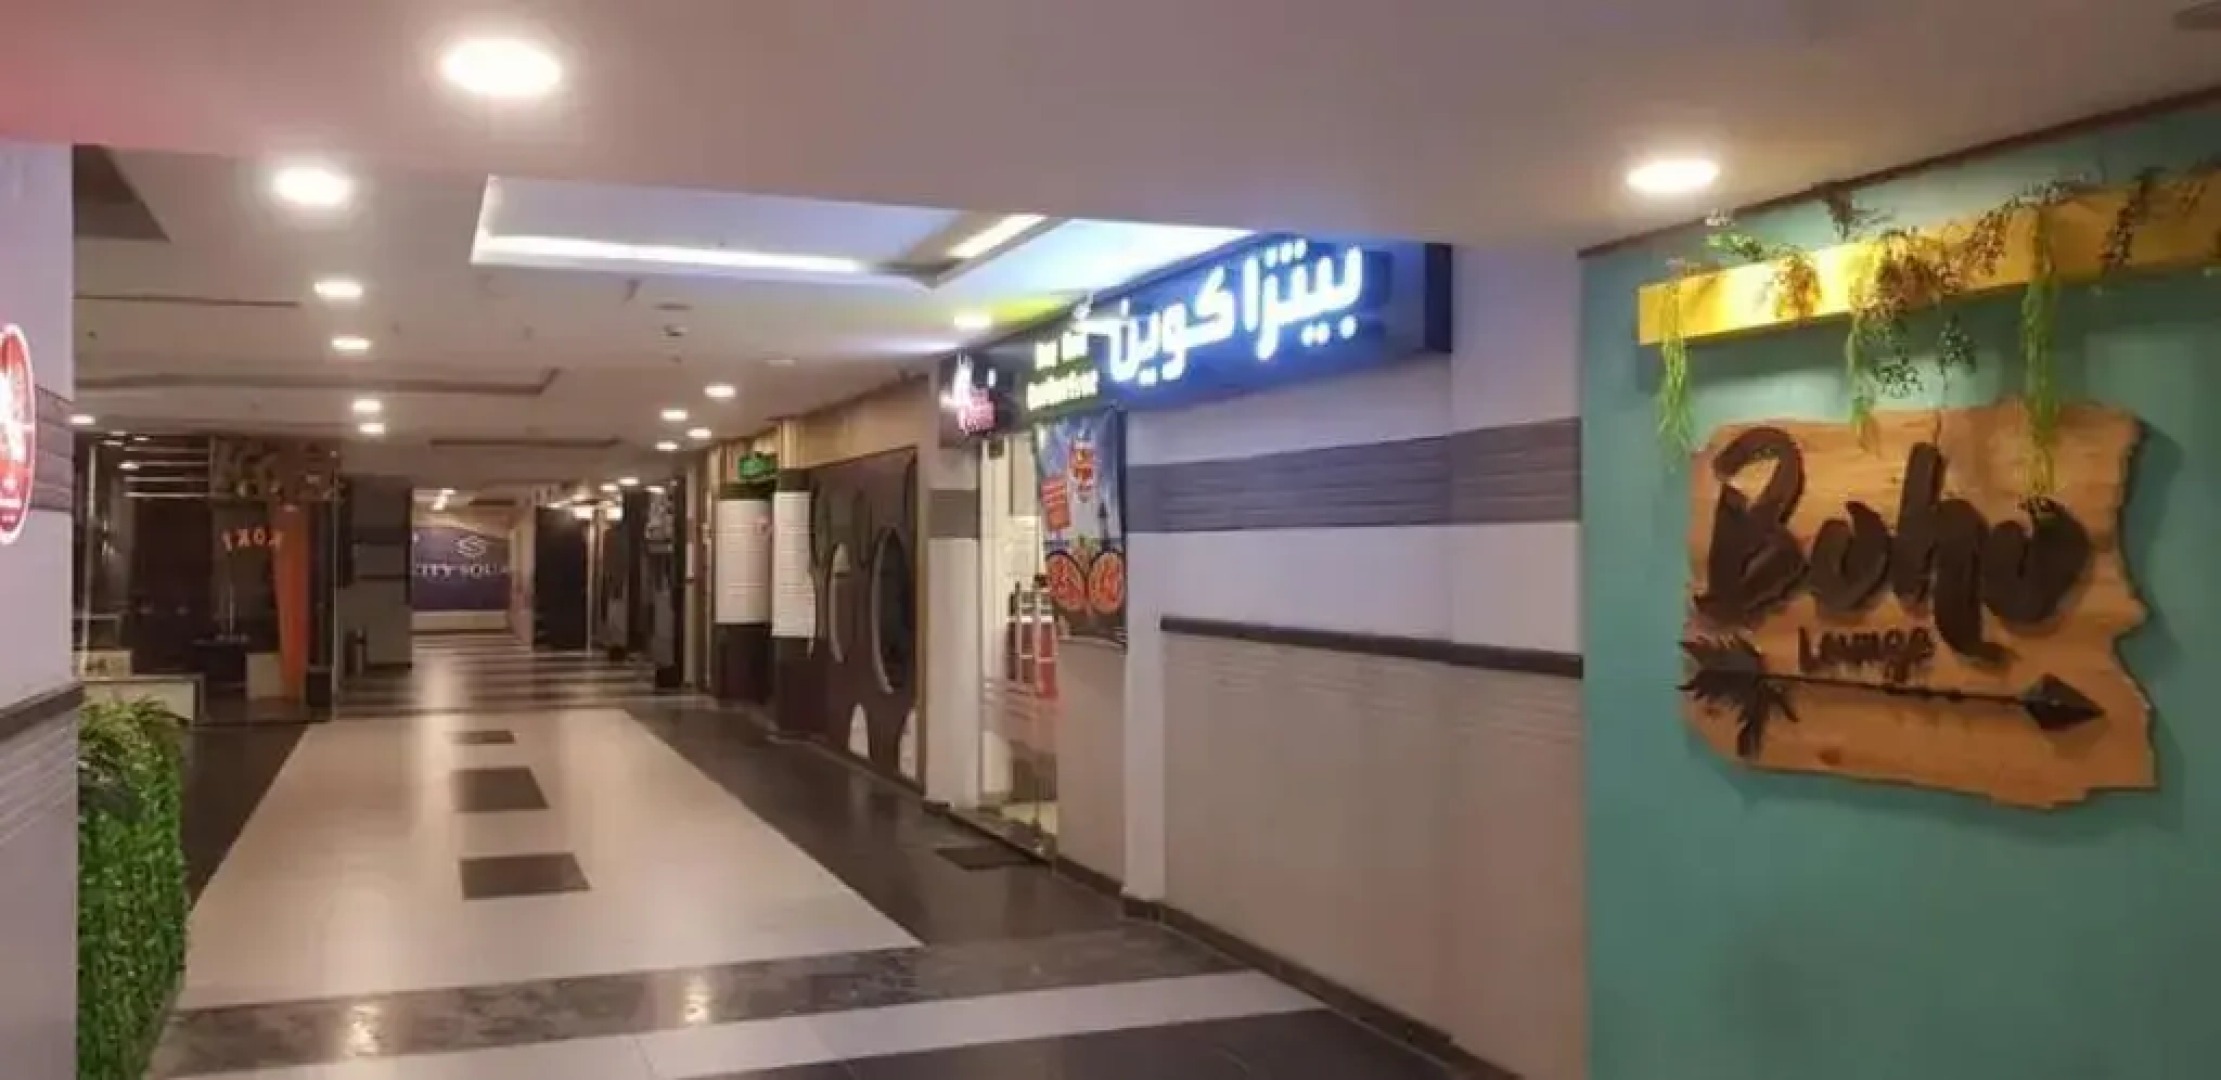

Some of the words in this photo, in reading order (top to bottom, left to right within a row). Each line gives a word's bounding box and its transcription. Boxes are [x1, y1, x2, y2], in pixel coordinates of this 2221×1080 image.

[1080, 266, 1236, 387] كوين
[1242, 238, 1363, 362] بيتزا
[1693, 426, 2094, 666] Boho
[1798, 626, 1935, 681] Lounge
